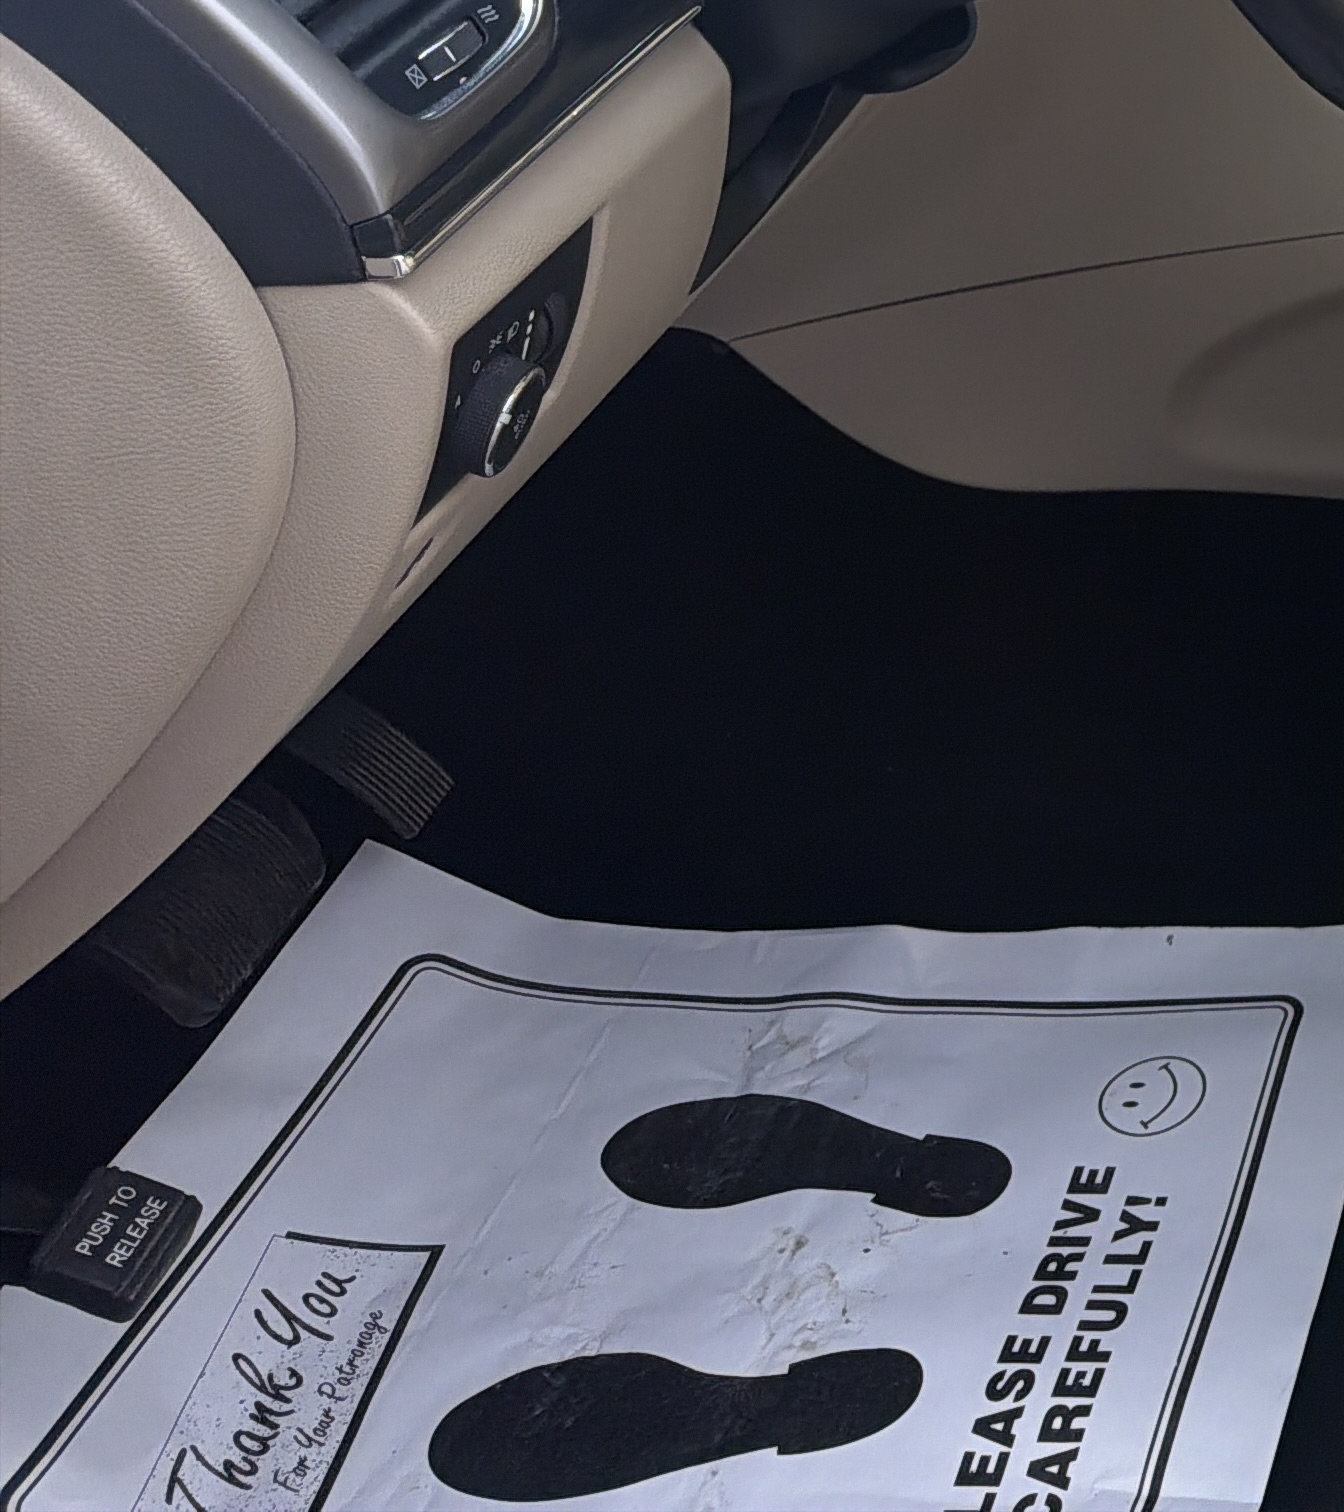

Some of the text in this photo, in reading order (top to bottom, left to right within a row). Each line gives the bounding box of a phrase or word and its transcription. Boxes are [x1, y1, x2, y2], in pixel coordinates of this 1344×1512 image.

[74, 1185, 137, 1257] PUSH TO
[104, 1195, 169, 1268] RELEASE
[1017, 1165, 1117, 1316] DRIVE
[165, 1271, 357, 1512] Thank You
[272, 1454, 309, 1493] For
[317, 1309, 388, 1402] Patronage
